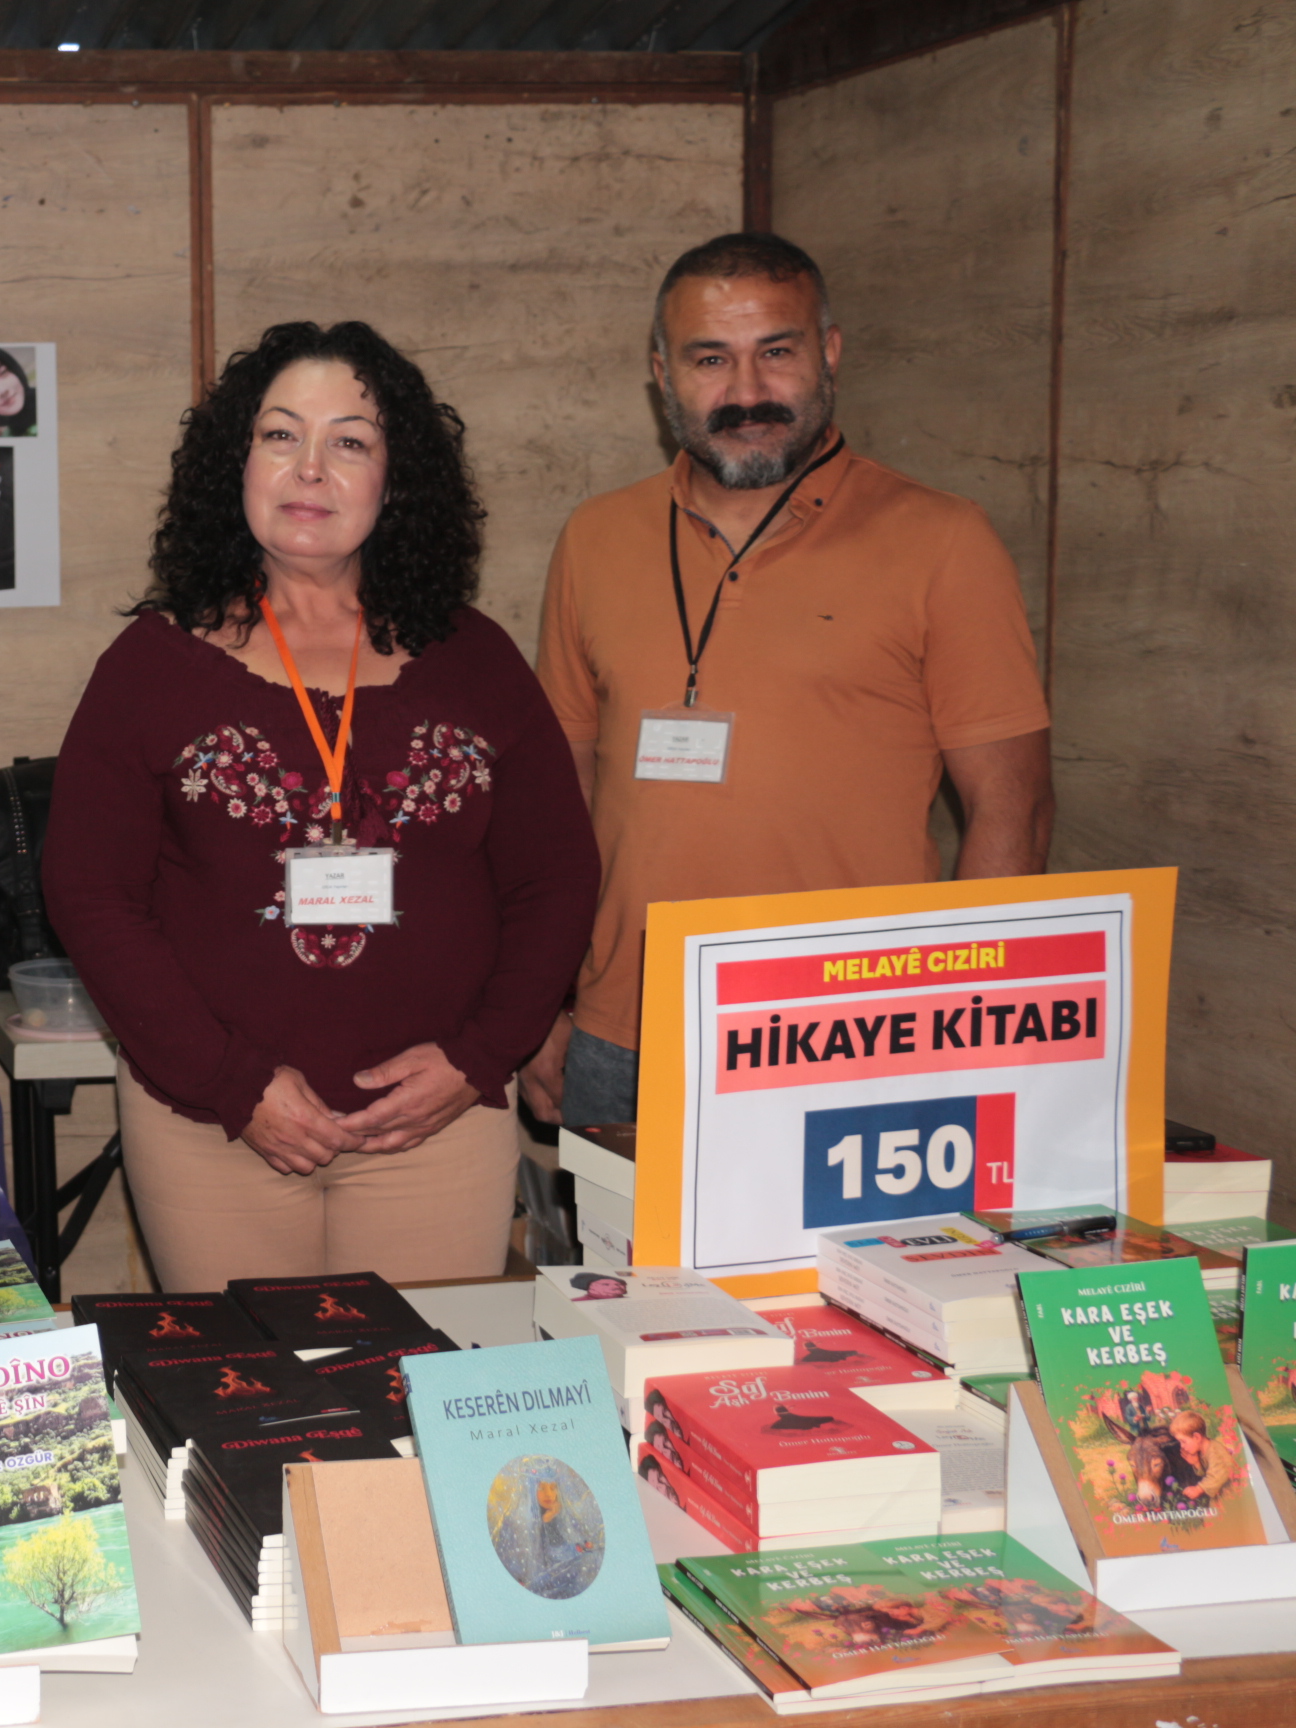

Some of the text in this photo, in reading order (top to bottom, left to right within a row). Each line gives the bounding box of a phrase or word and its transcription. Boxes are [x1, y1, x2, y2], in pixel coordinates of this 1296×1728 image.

[298, 895, 375, 905] MARAL XEZAL
[823, 941, 1005, 983] MELAYÊ CIZİRİ
[725, 995, 1098, 1071] HİKAYE KİTABI
[826, 1124, 974, 1200] 150
[986, 1161, 1014, 1185] TL
[1078, 1285, 1113, 1296] MELAYÊ
[1061, 1300, 1174, 1326] KARA EŞEK
[1108, 1325, 1135, 1344] VE
[1086, 1342, 1168, 1367] KERBEŞ
[443, 1379, 592, 1420] KESERÊN DILMAYÎ
[770, 1388, 830, 1402] Benim
[14, 1394, 46, 1416] ŞÎN
[470, 1418, 575, 1441] Maral Xezal
[1112, 1507, 1218, 1525] ÖMER HATTAPOĞLU
[882, 1548, 997, 1566] KARA EŞEK
[936, 1559, 966, 1570] VE
[730, 1558, 849, 1578] KARA EŞEK
[785, 1570, 814, 1580] VE
[919, 1566, 1005, 1581] KERBEŞ
[766, 1574, 852, 1592] KERBEŞ
